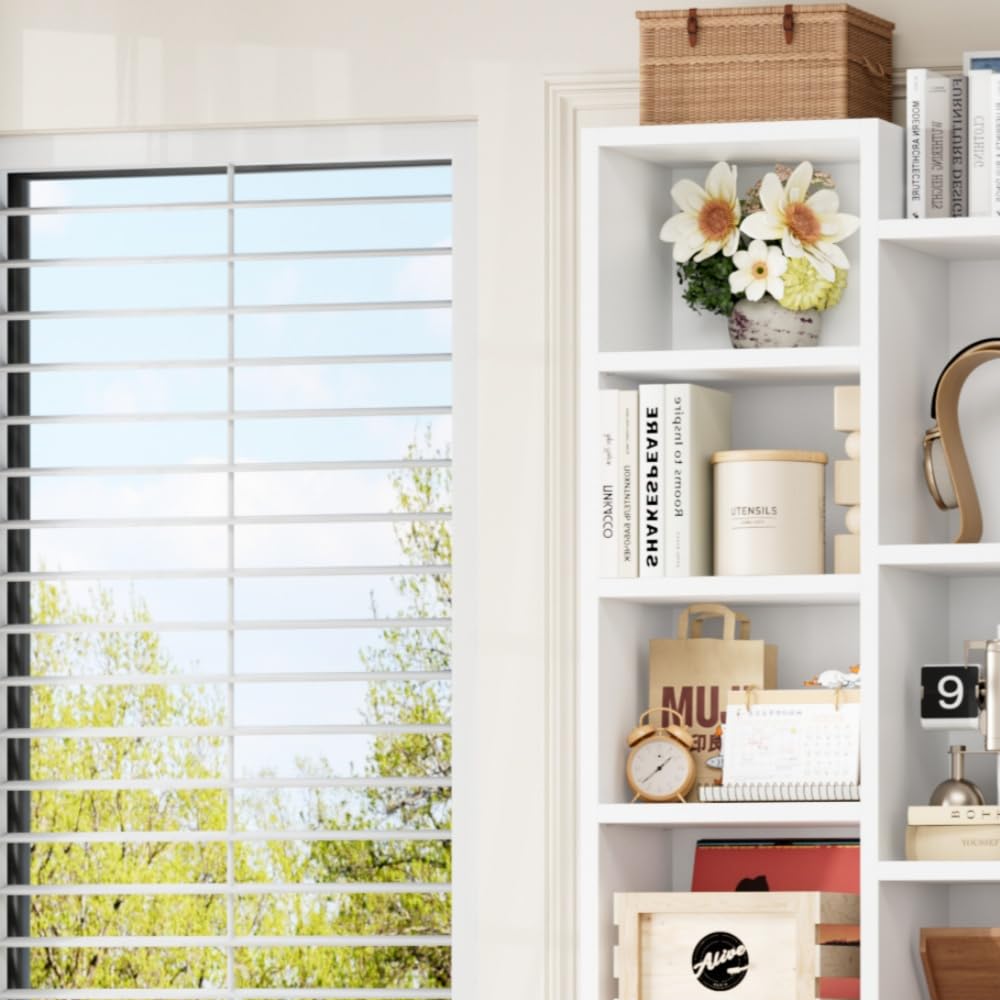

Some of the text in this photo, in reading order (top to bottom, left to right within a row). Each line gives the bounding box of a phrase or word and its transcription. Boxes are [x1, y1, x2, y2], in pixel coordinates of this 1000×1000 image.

[731, 506, 777, 515] UTENSILS
[937, 675, 964, 710] 9
[694, 945, 747, 978] Alive
